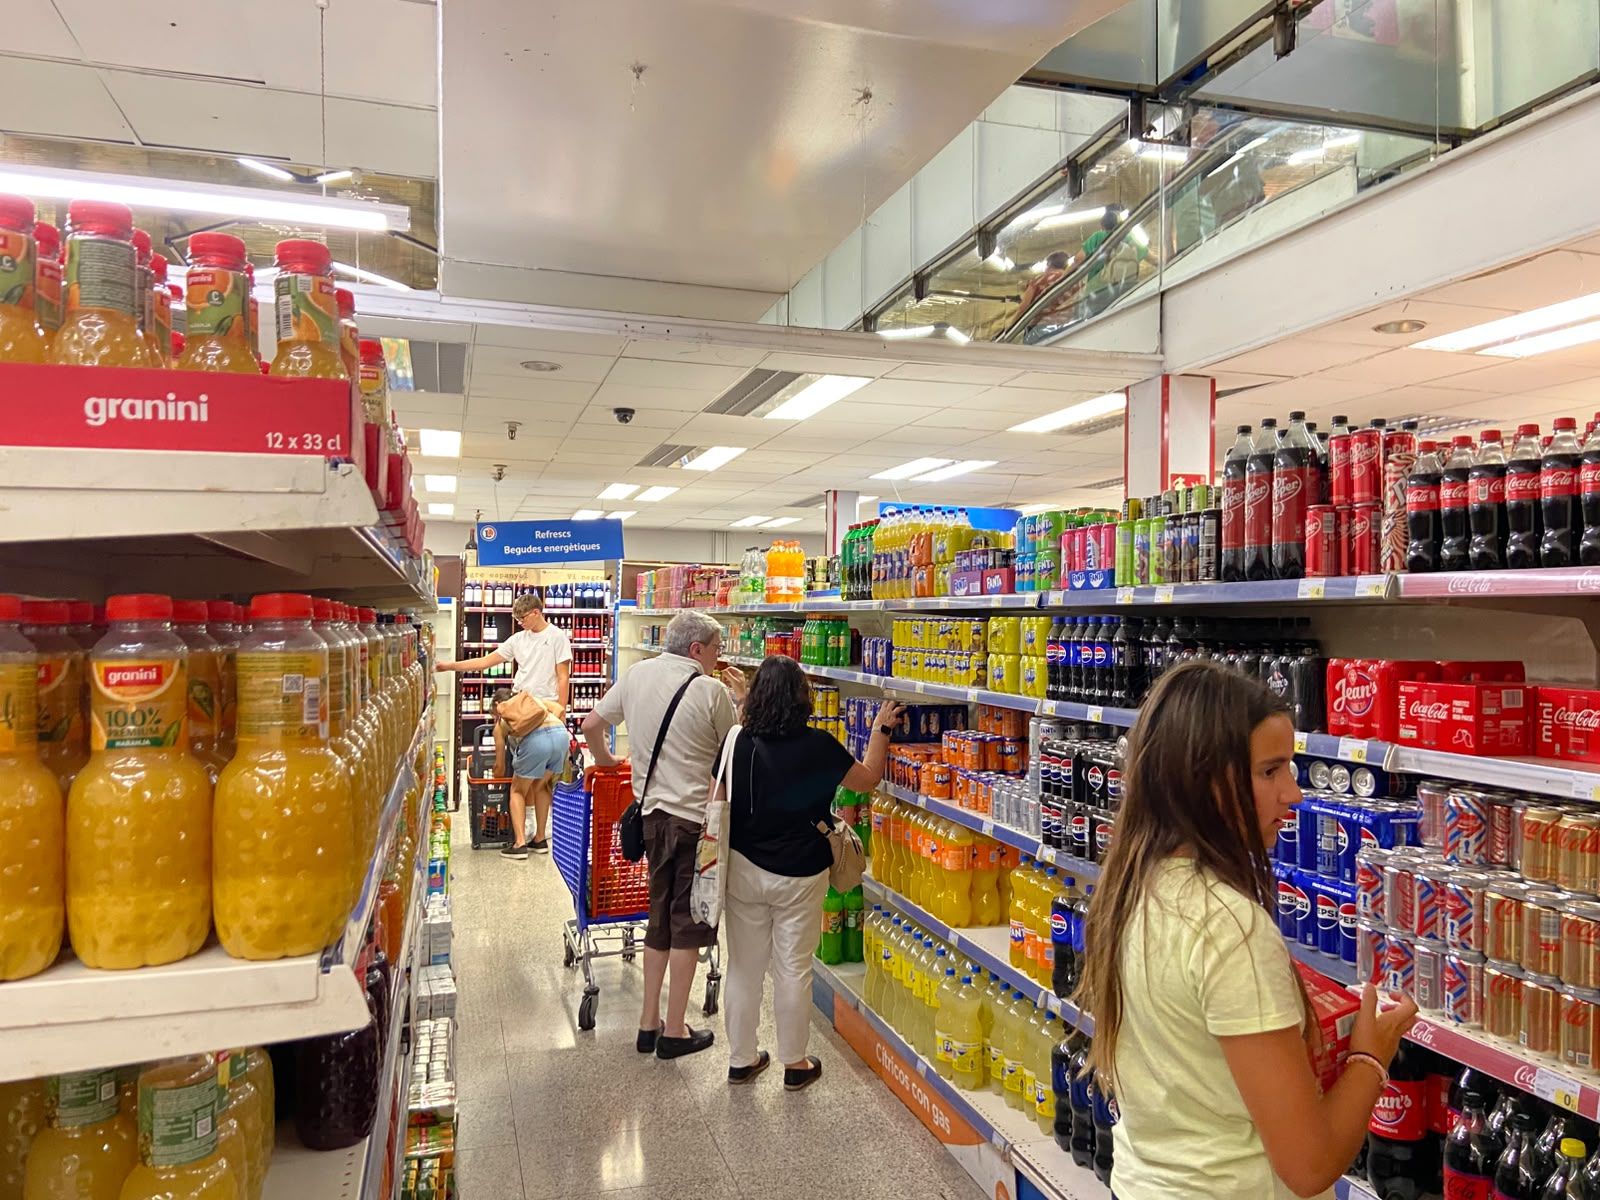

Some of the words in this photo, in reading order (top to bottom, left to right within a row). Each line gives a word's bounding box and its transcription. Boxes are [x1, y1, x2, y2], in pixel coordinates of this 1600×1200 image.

[84, 392, 209, 426] granini
[265, 432, 283, 448] 12
[287, 438, 297, 449] x
[302, 433, 322, 450] 33
[326, 434, 341, 451] cl
[535, 530, 572, 540] Refrescs
[504, 545, 542, 556] Begudes
[544, 543, 601, 554] energètiques
[986, 575, 1002, 589] FANTA
[108, 669, 157, 684] granini
[1333, 678, 1377, 712] Jean's
[105, 708, 161, 727] 100%
[1539, 702, 1553, 743] mini
[1318, 907, 1338, 917] EPSI
[911, 1082, 930, 1113] con
[931, 1103, 951, 1136] gas
[1375, 1094, 1413, 1109] an's
